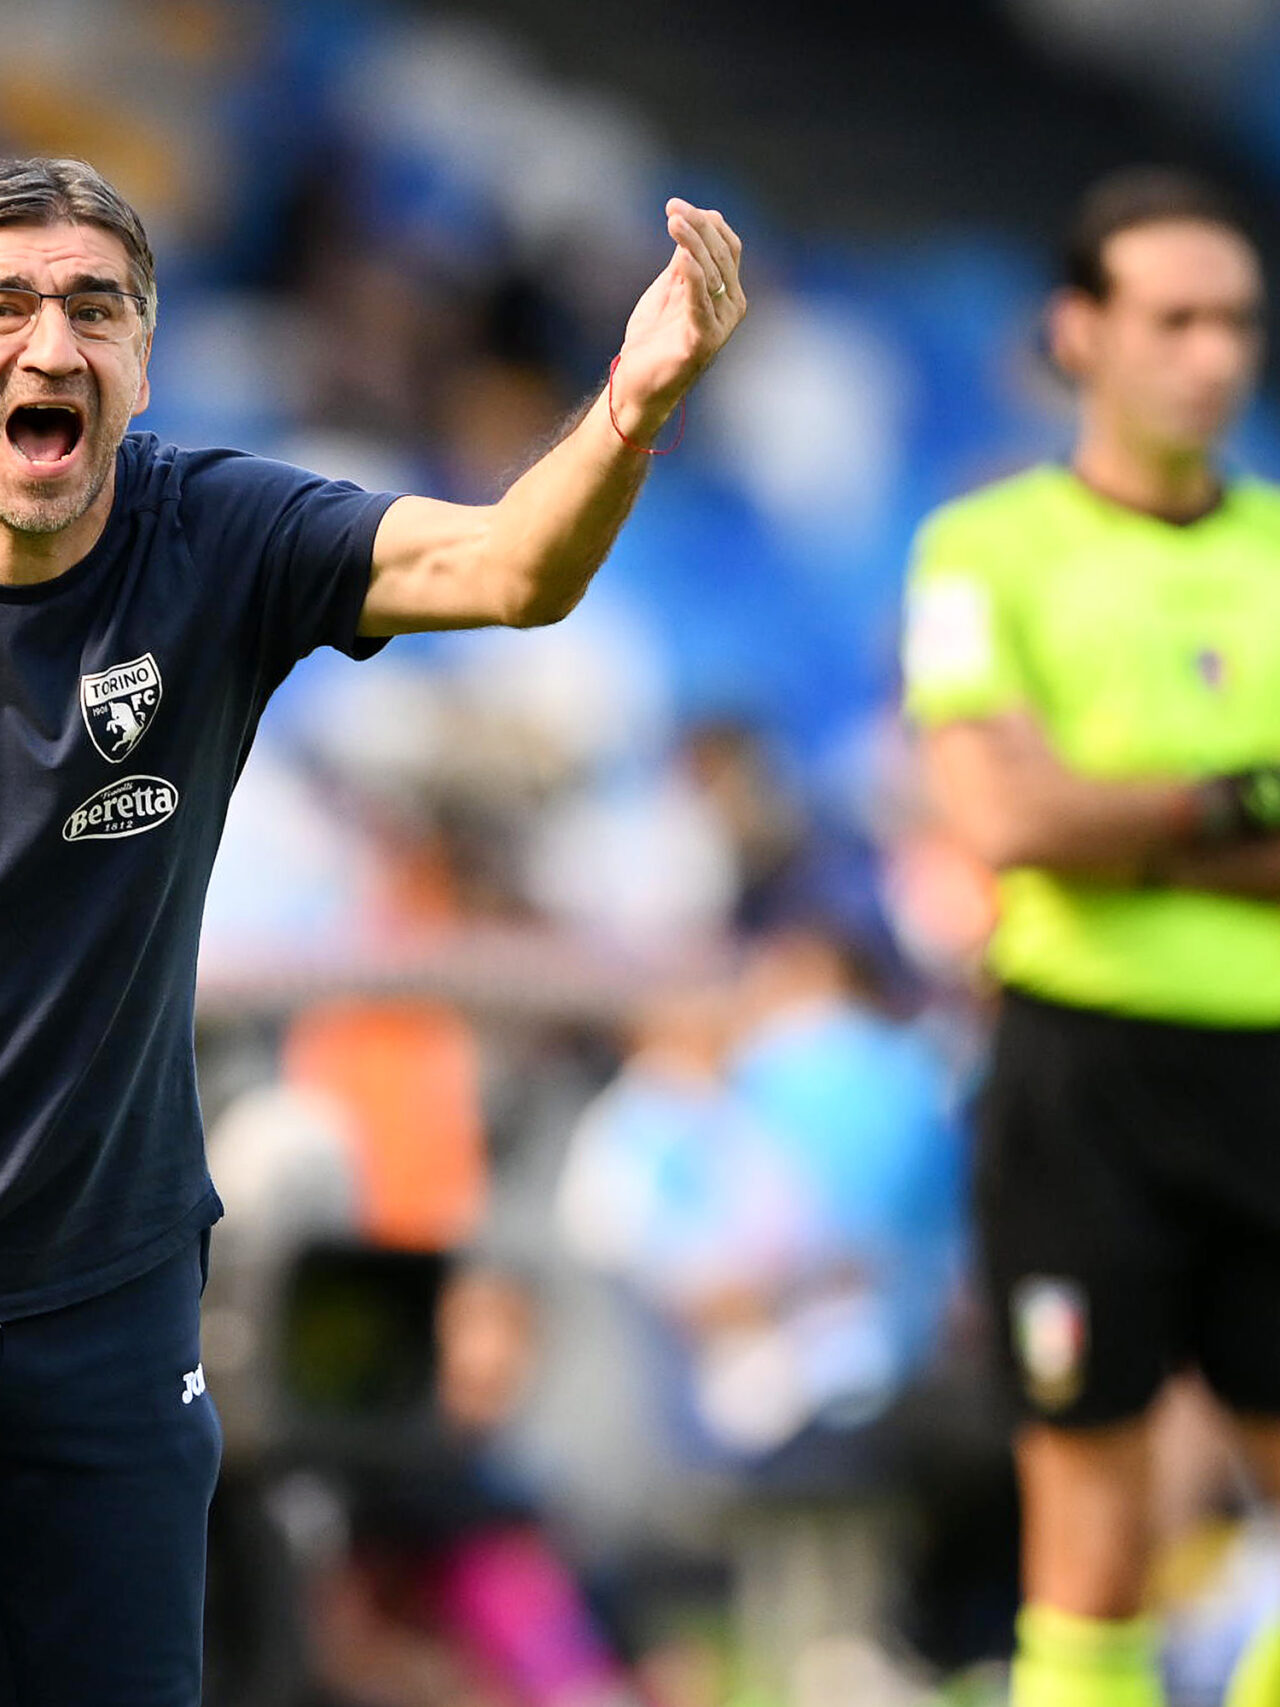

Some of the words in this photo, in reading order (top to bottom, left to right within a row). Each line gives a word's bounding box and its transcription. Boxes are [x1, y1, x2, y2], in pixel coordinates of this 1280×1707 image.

[90, 668, 148, 698] TORINO
[130, 689, 155, 711] FC
[69, 786, 174, 838] Beretta
[105, 820, 133, 832] 1812
